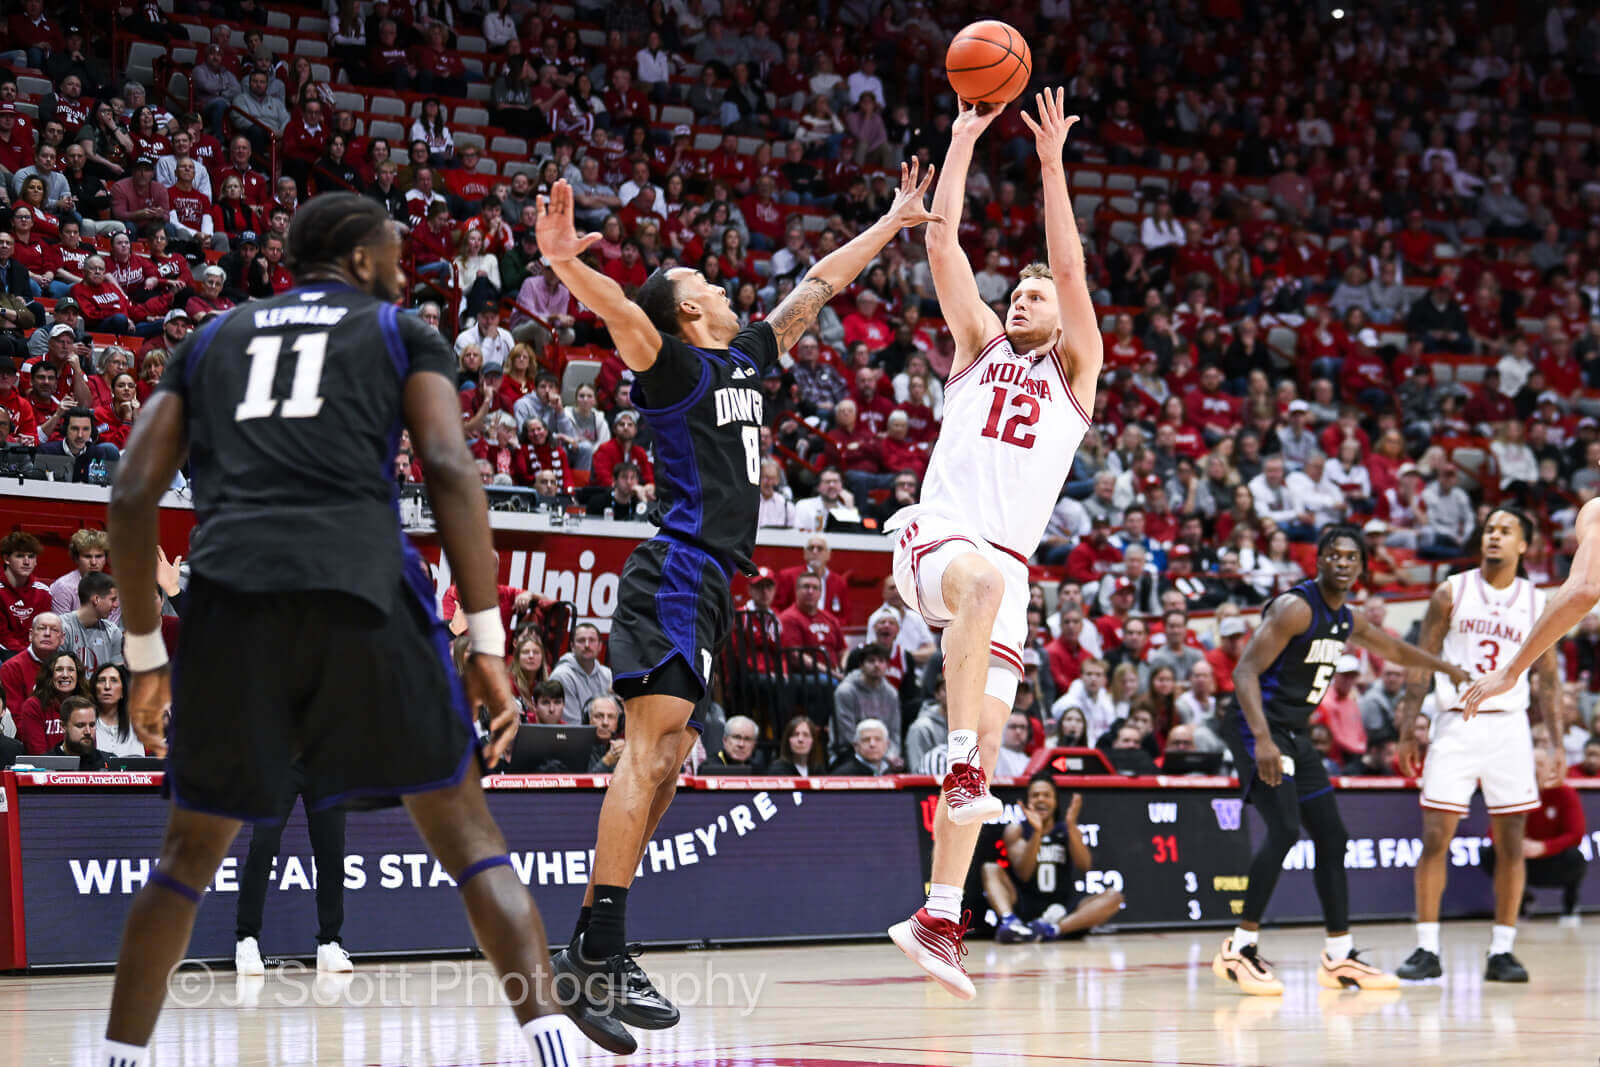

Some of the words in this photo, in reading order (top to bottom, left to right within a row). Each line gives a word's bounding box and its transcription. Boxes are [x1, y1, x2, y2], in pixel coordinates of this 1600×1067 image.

[234, 332, 329, 422] 11
[979, 362, 1053, 402] INDIANA
[981, 386, 1041, 449] 12
[508, 549, 620, 617] Unio
[1459, 618, 1524, 645] INDIANA
[1475, 639, 1501, 674] 3
[1306, 665, 1334, 705] 5
[49, 774, 88, 785] German
[87, 774, 130, 785] American
[130, 774, 153, 785] Bank
[1148, 802, 1178, 823] UW
[1211, 798, 1243, 830] W
[1151, 835, 1179, 864] 31
[1379, 838, 1424, 868] FAN
[69, 855, 240, 895] WHE
[379, 853, 458, 889] STA
[507, 848, 597, 886] WHE
[1037, 863, 1057, 893] 0
[1184, 871, 1199, 893] 3
[1187, 899, 1202, 920] 3
